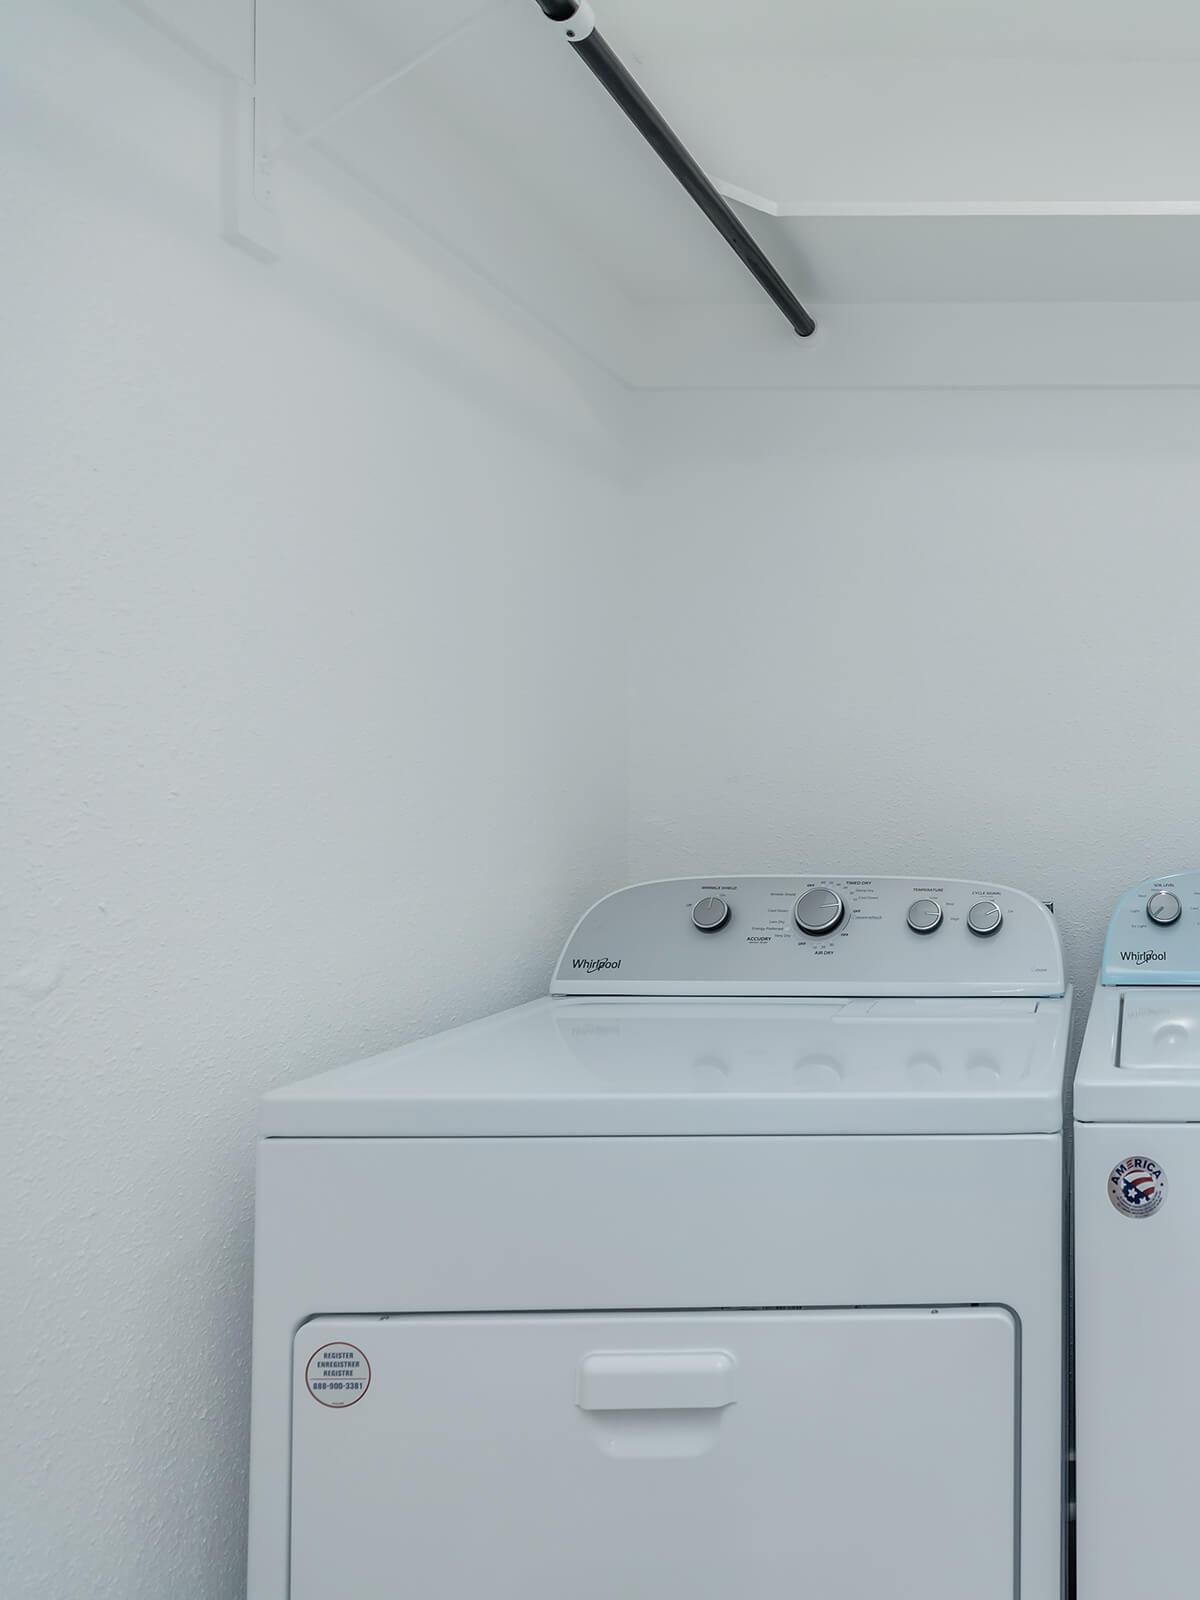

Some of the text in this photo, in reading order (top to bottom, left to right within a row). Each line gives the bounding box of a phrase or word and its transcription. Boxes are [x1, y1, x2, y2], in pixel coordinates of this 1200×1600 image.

[572, 957, 622, 973] Whirlpool
[1120, 950, 1167, 965] Whirlpool
[1111, 1158, 1162, 1185] AMERICA
[313, 1382, 363, 1390] 888-900-3381
